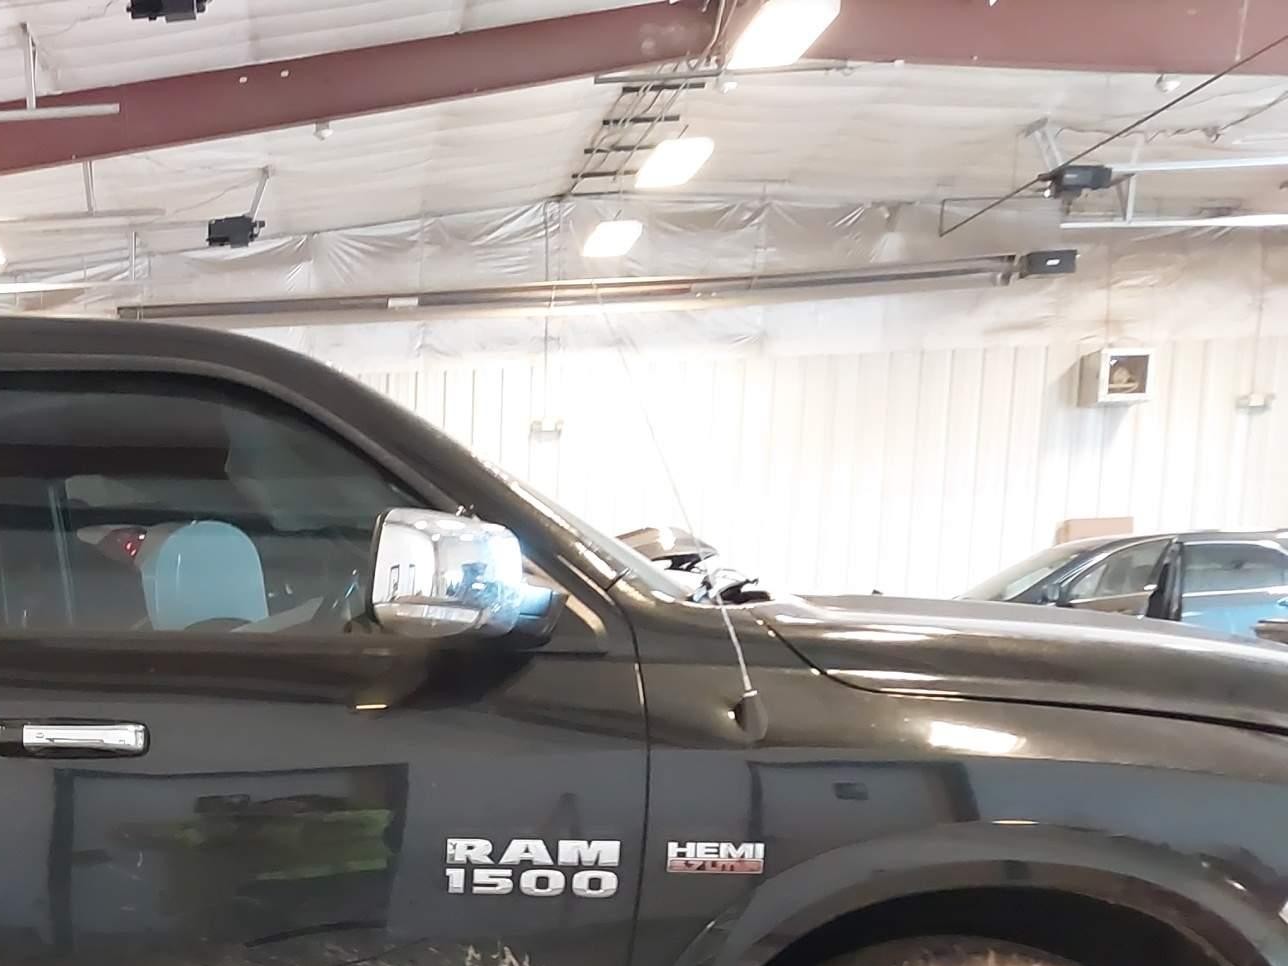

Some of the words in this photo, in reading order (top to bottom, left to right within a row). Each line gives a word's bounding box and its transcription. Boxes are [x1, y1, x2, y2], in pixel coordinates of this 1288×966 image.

[446, 838, 621, 866] RAM
[667, 841, 765, 858] HEMI
[445, 868, 619, 898] 1500
